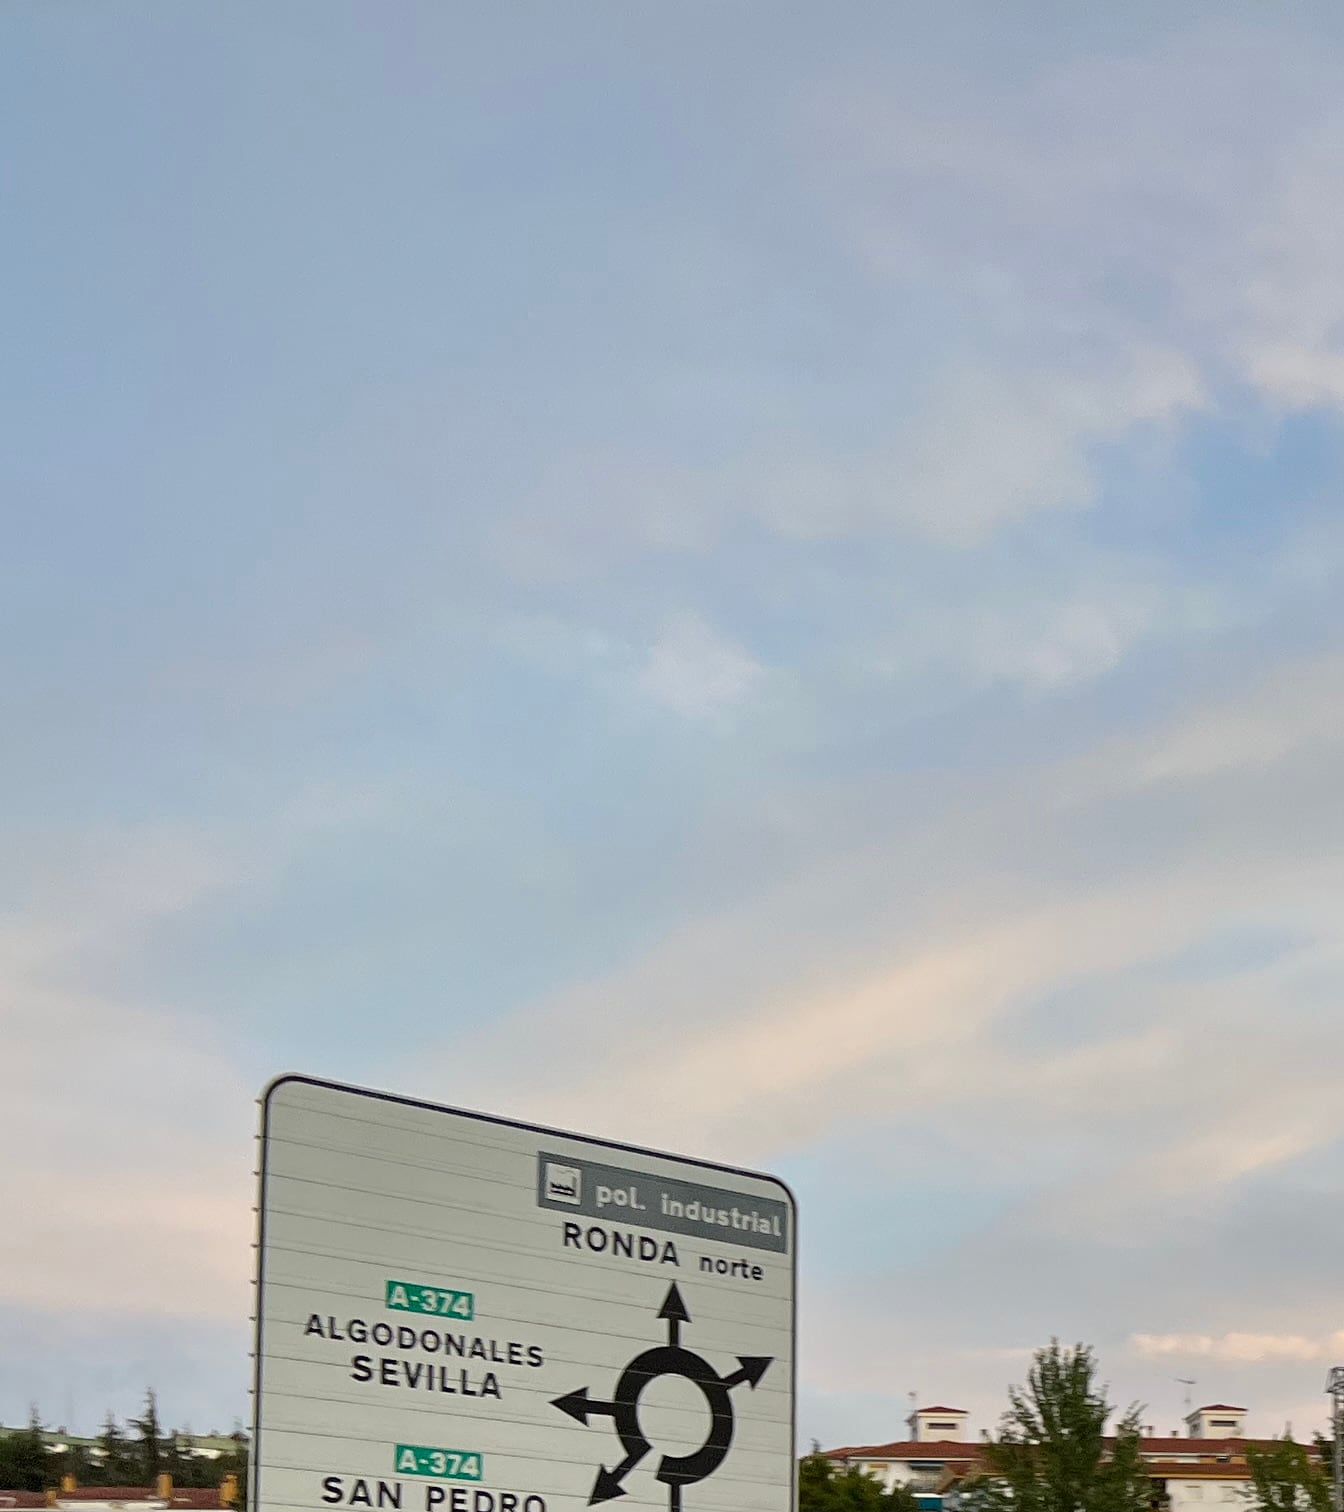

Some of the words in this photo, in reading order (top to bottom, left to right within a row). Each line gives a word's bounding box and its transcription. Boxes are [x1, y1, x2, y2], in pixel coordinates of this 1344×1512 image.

[595, 1184, 647, 1211] pol.
[660, 1192, 782, 1238] industrial
[562, 1221, 680, 1267] RONDA
[699, 1254, 765, 1282] norte
[388, 1285, 471, 1318] A-374
[304, 1313, 545, 1368] ALGODONALES
[350, 1354, 503, 1400] SEVILLA
[398, 1449, 481, 1477] A-374
[321, 1476, 402, 1510] SAN
